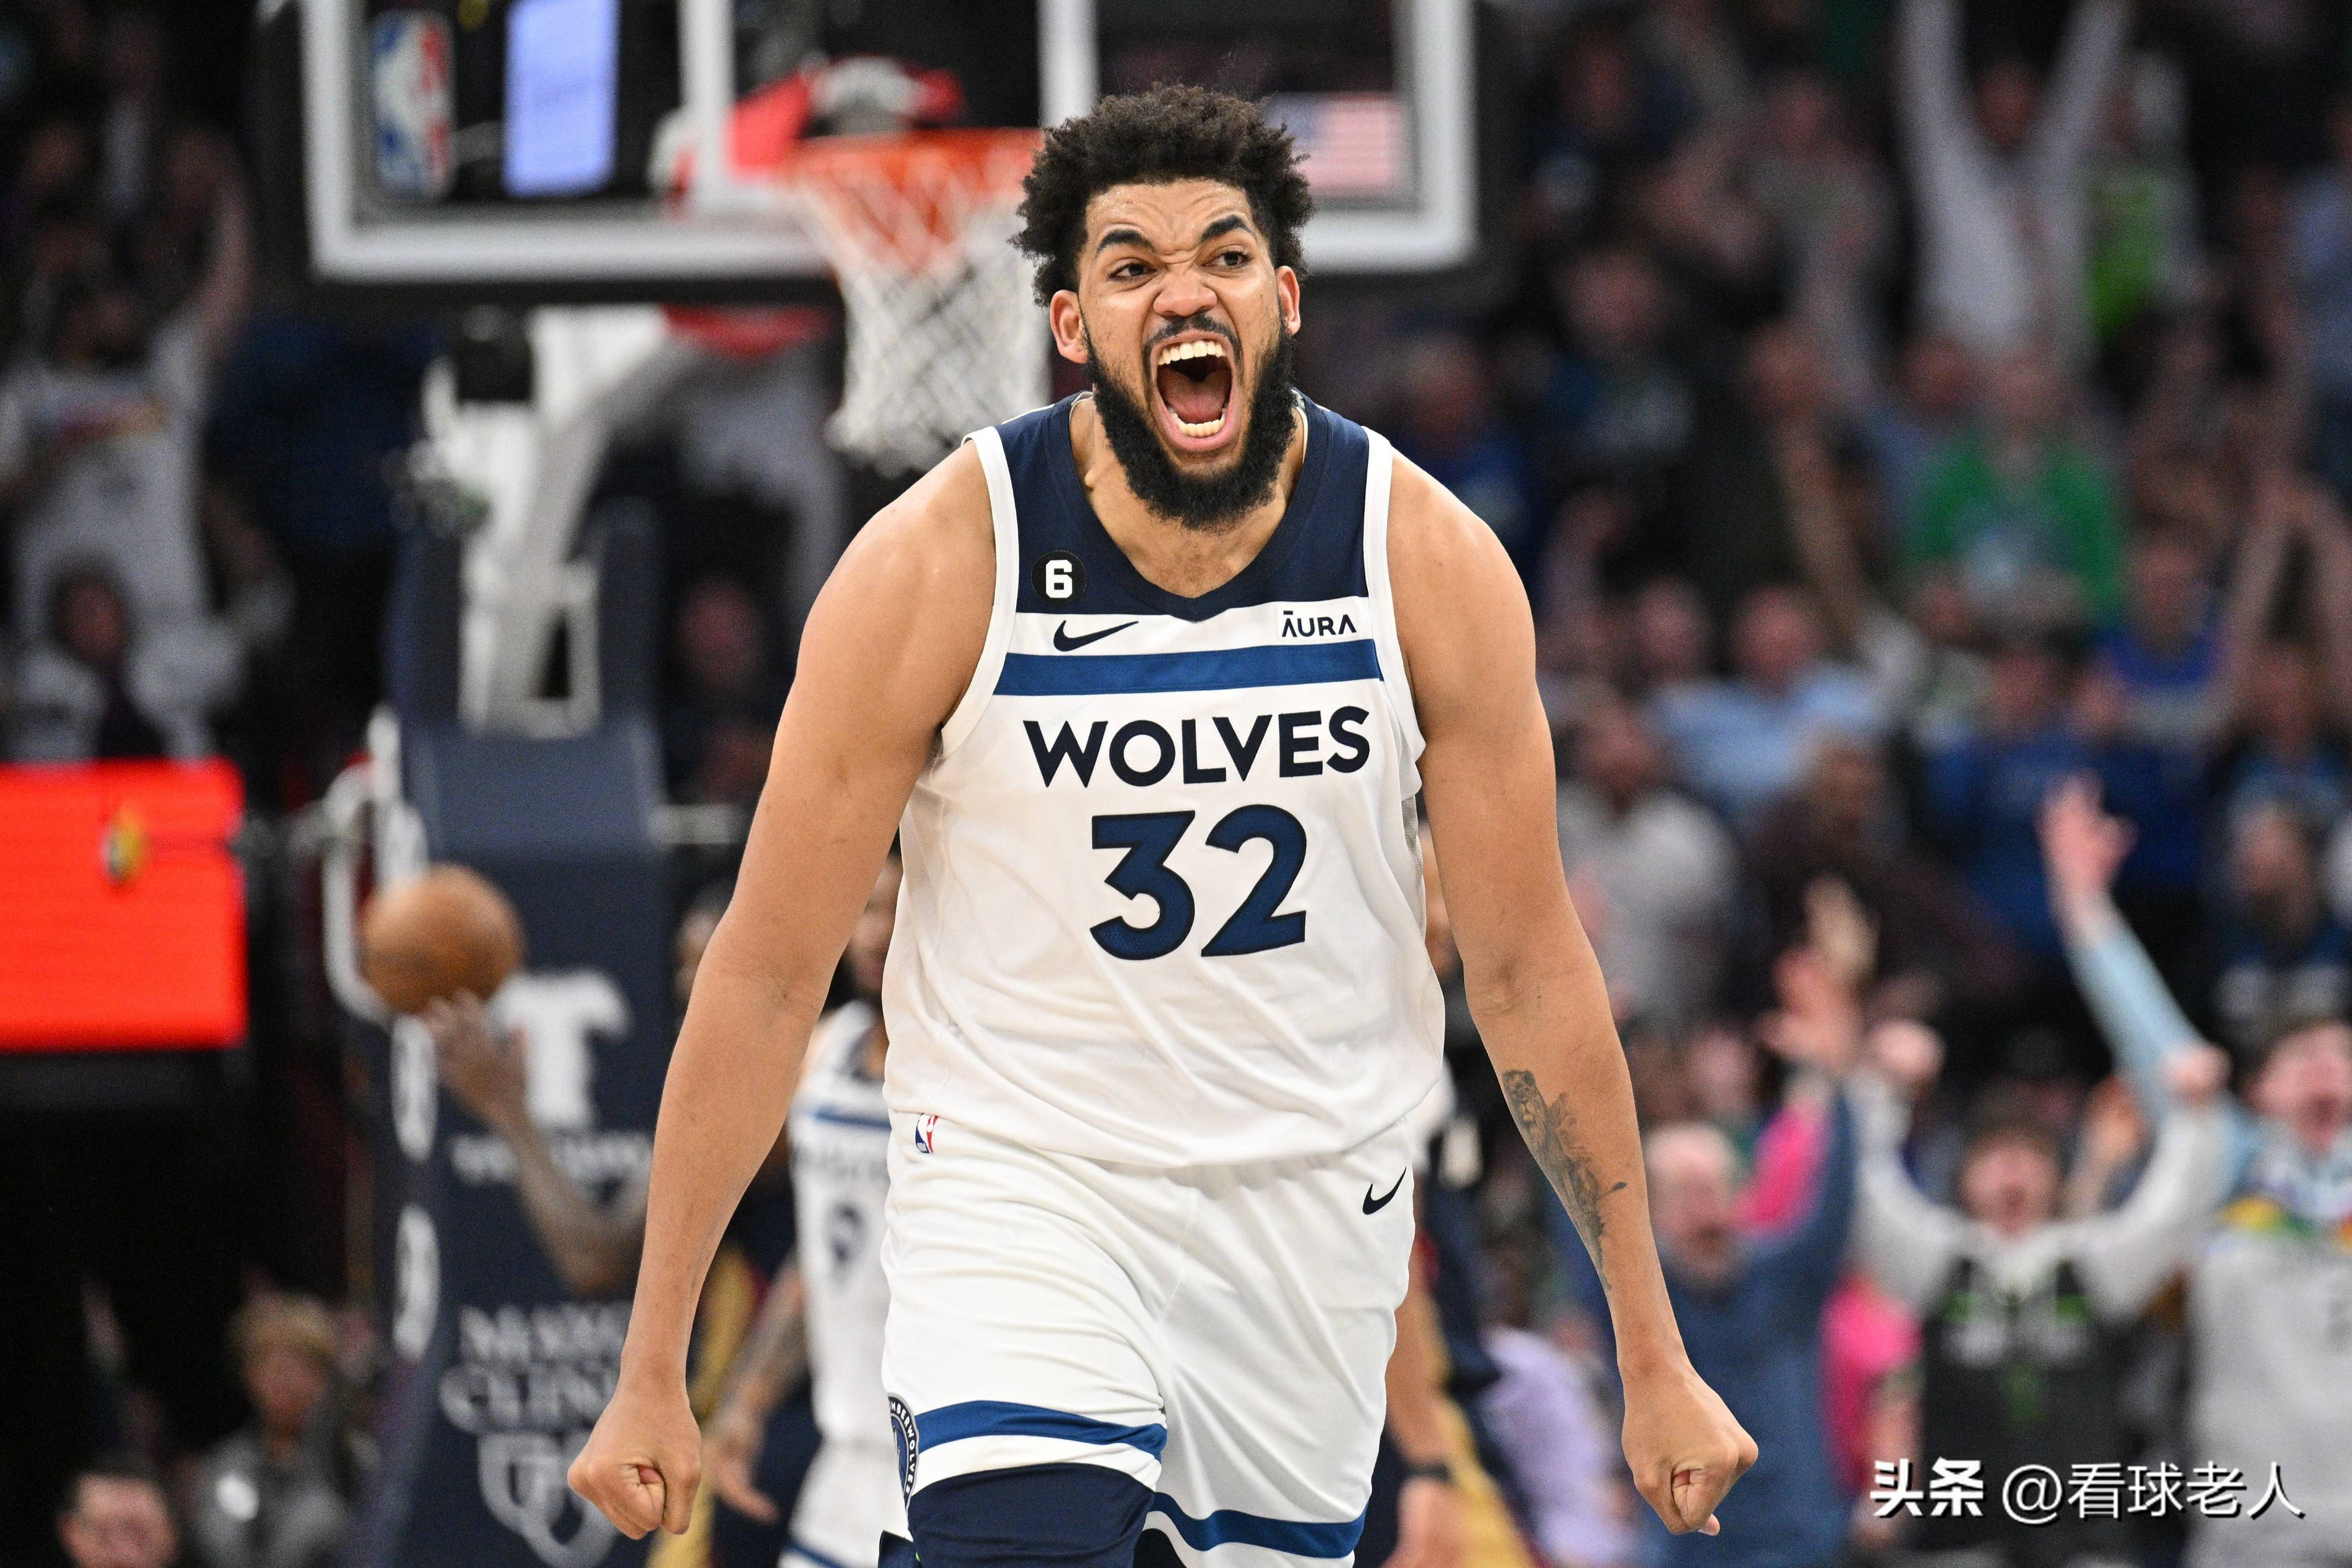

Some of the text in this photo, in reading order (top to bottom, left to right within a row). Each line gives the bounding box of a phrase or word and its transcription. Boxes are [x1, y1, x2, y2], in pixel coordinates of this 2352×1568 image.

[1045, 559, 1072, 598] 6
[1023, 706, 1370, 788] WOLVES
[1089, 804, 1307, 961] 32
